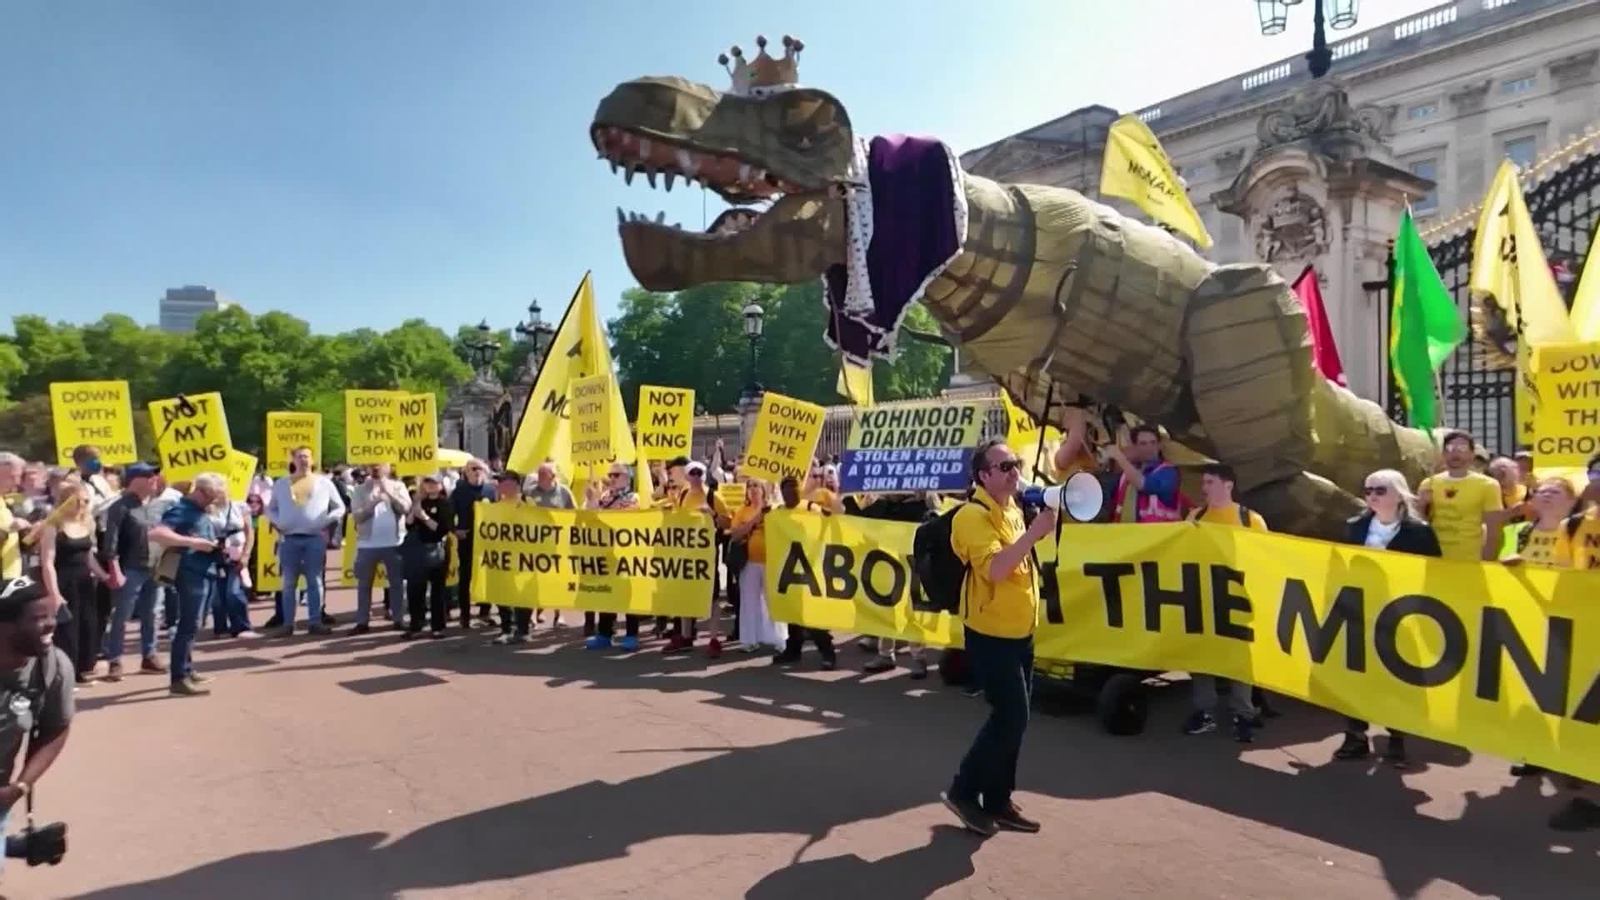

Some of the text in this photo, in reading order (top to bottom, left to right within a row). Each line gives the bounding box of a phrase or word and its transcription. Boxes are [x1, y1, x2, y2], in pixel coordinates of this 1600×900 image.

[61, 390, 120, 404] DOWN
[574, 383, 606, 399] DOWN
[649, 390, 686, 407] NOT
[354, 397, 392, 408] DOW
[400, 399, 428, 416] NOT
[577, 402, 602, 415] WITH
[69, 408, 117, 421] WITH
[651, 412, 680, 428] MY
[769, 403, 818, 425] DOWN
[859, 406, 975, 429] KOHINOOR
[273, 419, 315, 429] DOWN
[404, 422, 425, 440] MY
[580, 421, 599, 434] THE
[768, 420, 808, 442] WITH
[77, 426, 113, 439] THE
[174, 423, 208, 444] MY
[278, 433, 311, 443] WITH
[365, 429, 394, 440] THE
[859, 427, 966, 449] DIAMOND
[572, 437, 610, 454] CROWN
[642, 433, 688, 449] KING
[1537, 436, 1600, 454] CRO
[62, 443, 133, 459] CWN
[168, 444, 226, 469] KING
[399, 446, 433, 462] KING
[768, 440, 797, 459] THE
[853, 449, 963, 462] STOLEN FROM
[747, 455, 807, 481] CROWN
[847, 461, 963, 477] A 10 YEAR OLD
[862, 475, 940, 490] SIKH KING
[479, 521, 711, 549] CORRUPT BILLIONAIRES
[480, 550, 711, 580] ARE NOT THE ANSWER
[1084, 558, 1255, 643] THE
[1276, 577, 1600, 725] MON
